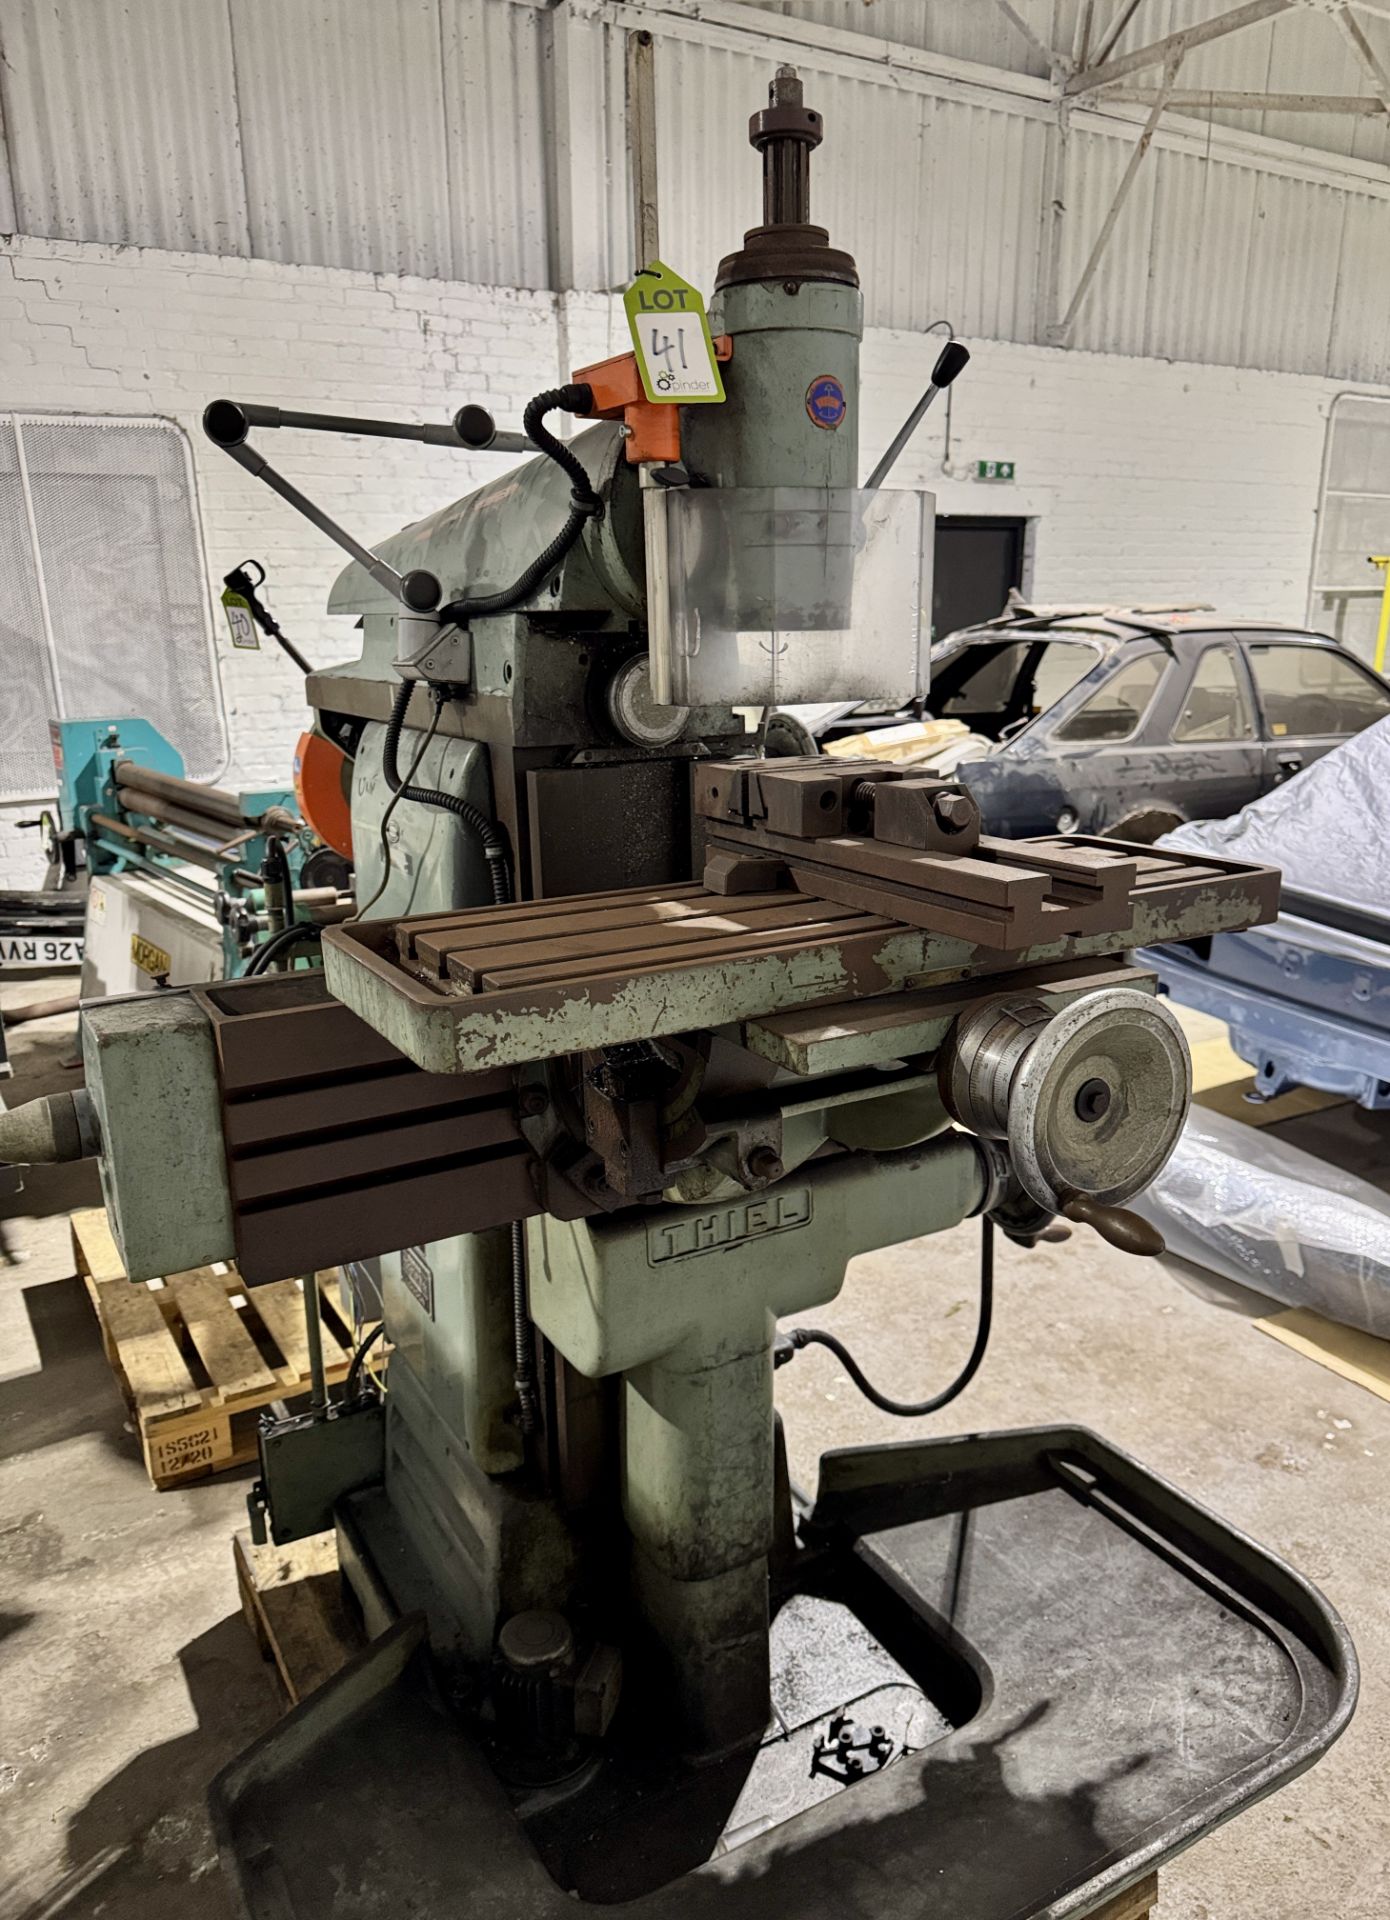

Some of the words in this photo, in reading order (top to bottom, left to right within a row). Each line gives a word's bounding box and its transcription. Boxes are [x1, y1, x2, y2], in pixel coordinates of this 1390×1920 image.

[638, 289, 688, 311] LOT
[651, 328, 688, 372] 41
[671, 378, 711, 393] pinder
[661, 1196, 799, 1256] THIEL
